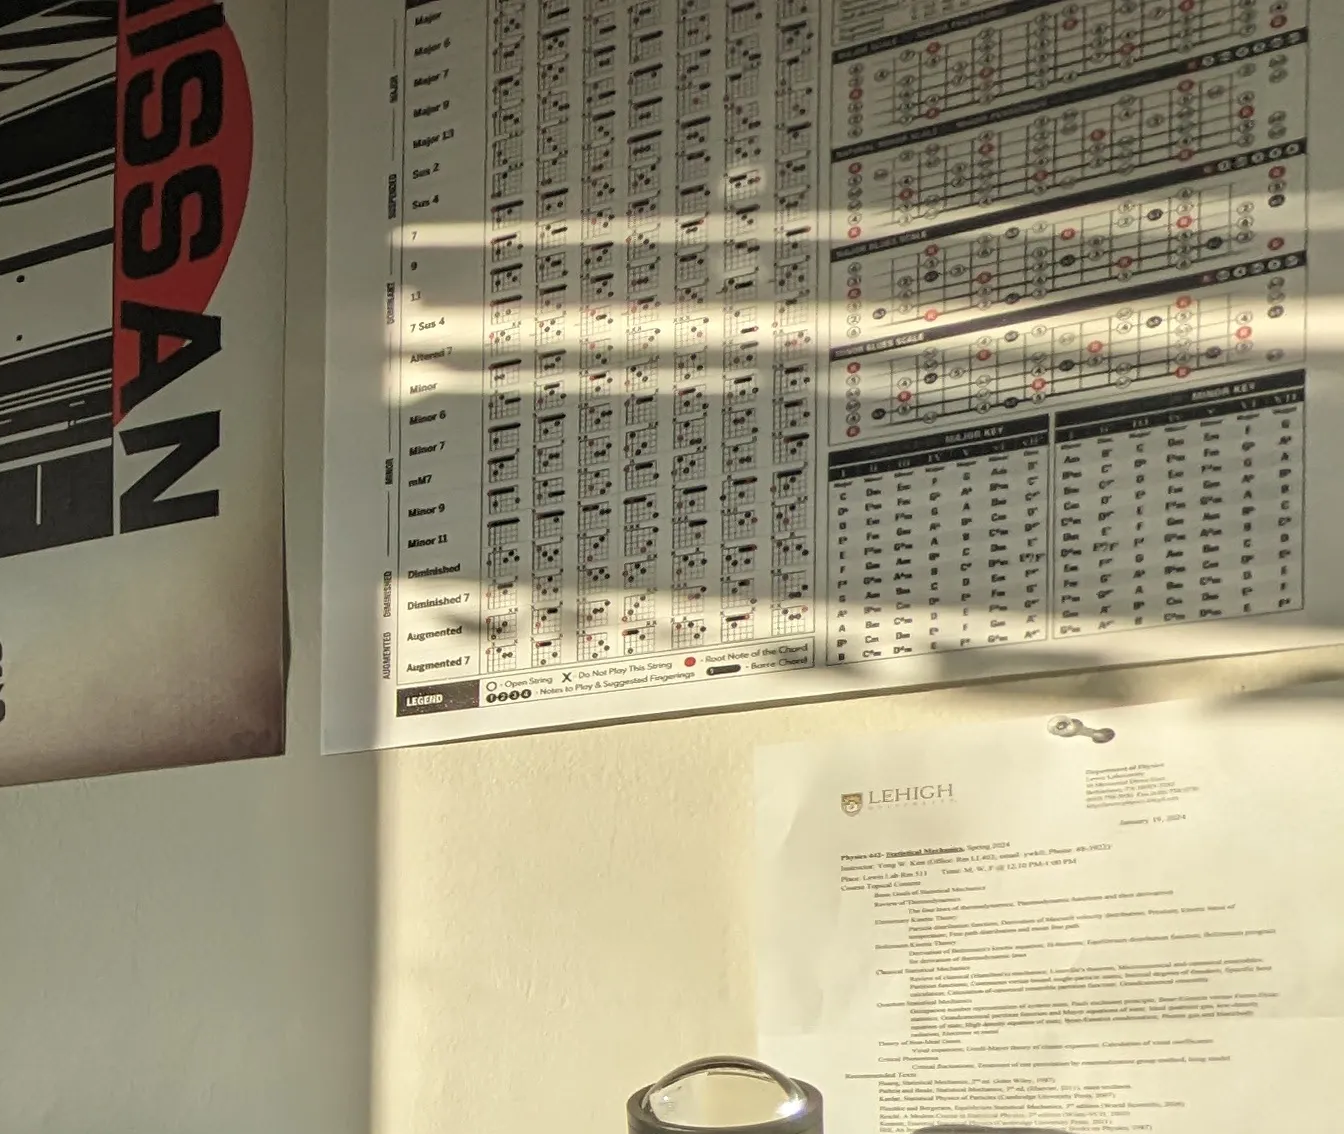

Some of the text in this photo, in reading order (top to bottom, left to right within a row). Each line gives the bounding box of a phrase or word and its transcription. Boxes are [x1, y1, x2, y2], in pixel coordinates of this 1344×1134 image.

[414, 12, 442, 27] Major
[414, 42, 441, 57] Major
[414, 69, 449, 87] Major 7
[413, 100, 449, 118] Major 9
[413, 135, 440, 149] Major
[412, 162, 440, 179] Sus 2
[412, 194, 439, 210] Sus 4
[411, 231, 417, 241] 7
[120, 0, 225, 534] ISSAN
[411, 261, 417, 271] 9
[410, 291, 422, 302] 11
[410, 316, 445, 333] 7 Sus 4
[410, 382, 438, 395] Minor
[410, 410, 446, 425] Minor 6
[945, 426, 1004, 442] MAJOR KEY
[409, 441, 445, 456] Minor 7
[408, 503, 445, 518] Minor 9
[408, 534, 448, 549] Minor 11
[408, 563, 461, 579] Diminished
[407, 593, 470, 611] Diminished 7
[407, 625, 462, 642] Augmented
[728, 650, 750, 660] Note
[751, 649, 761, 658] of
[762, 648, 776, 657] the
[779, 644, 808, 655] Chord
[406, 656, 470, 672] Augmented 7
[578, 660, 673, 679] Do Not Play This String
[778, 656, 808, 667] Chord
[505, 676, 553, 689] Open String
[540, 686, 563, 696] Notes
[565, 685, 573, 693] to
[575, 681, 593, 693] Play
[604, 674, 648, 689] Suggested
[406, 694, 443, 707] LEGEND
[868, 783, 953, 805] LEHIGH
